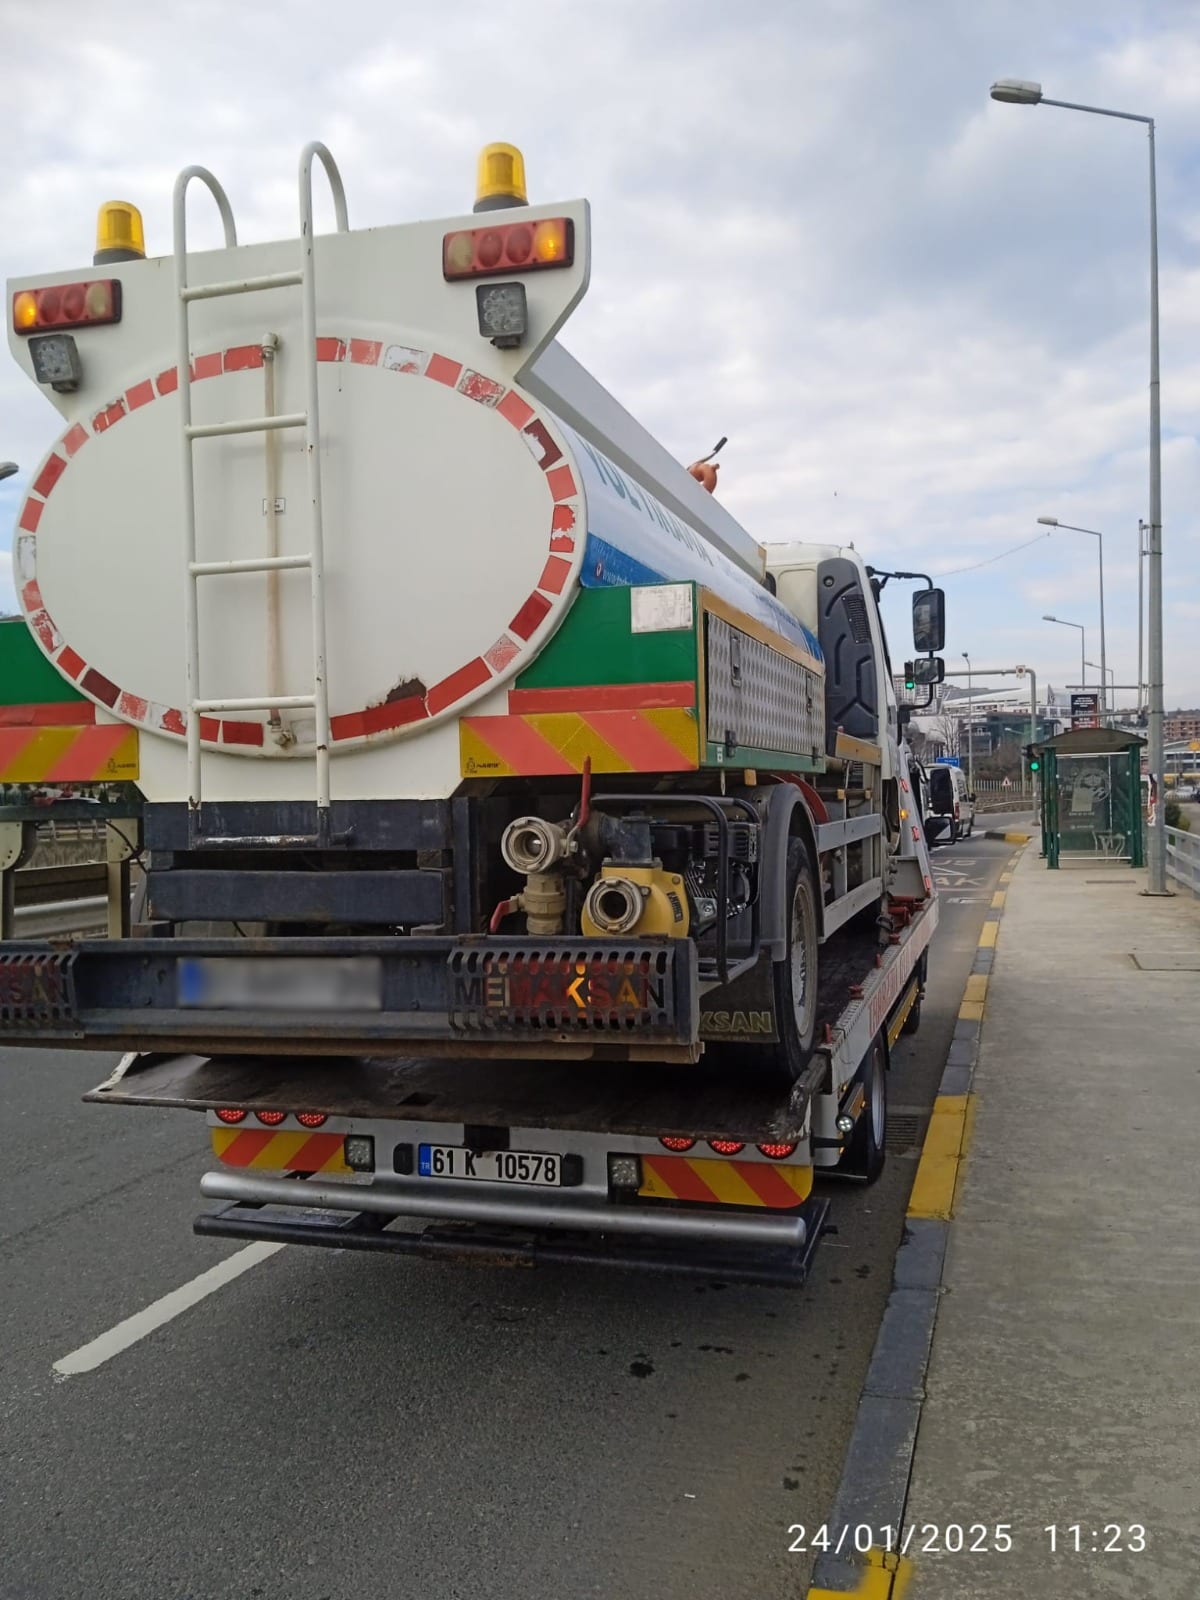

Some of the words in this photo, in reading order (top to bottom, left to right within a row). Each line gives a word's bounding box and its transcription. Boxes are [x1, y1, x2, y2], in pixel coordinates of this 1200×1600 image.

[433, 1148, 454, 1174] 61
[465, 1151, 476, 1176] K
[495, 1153, 556, 1182] 10578
